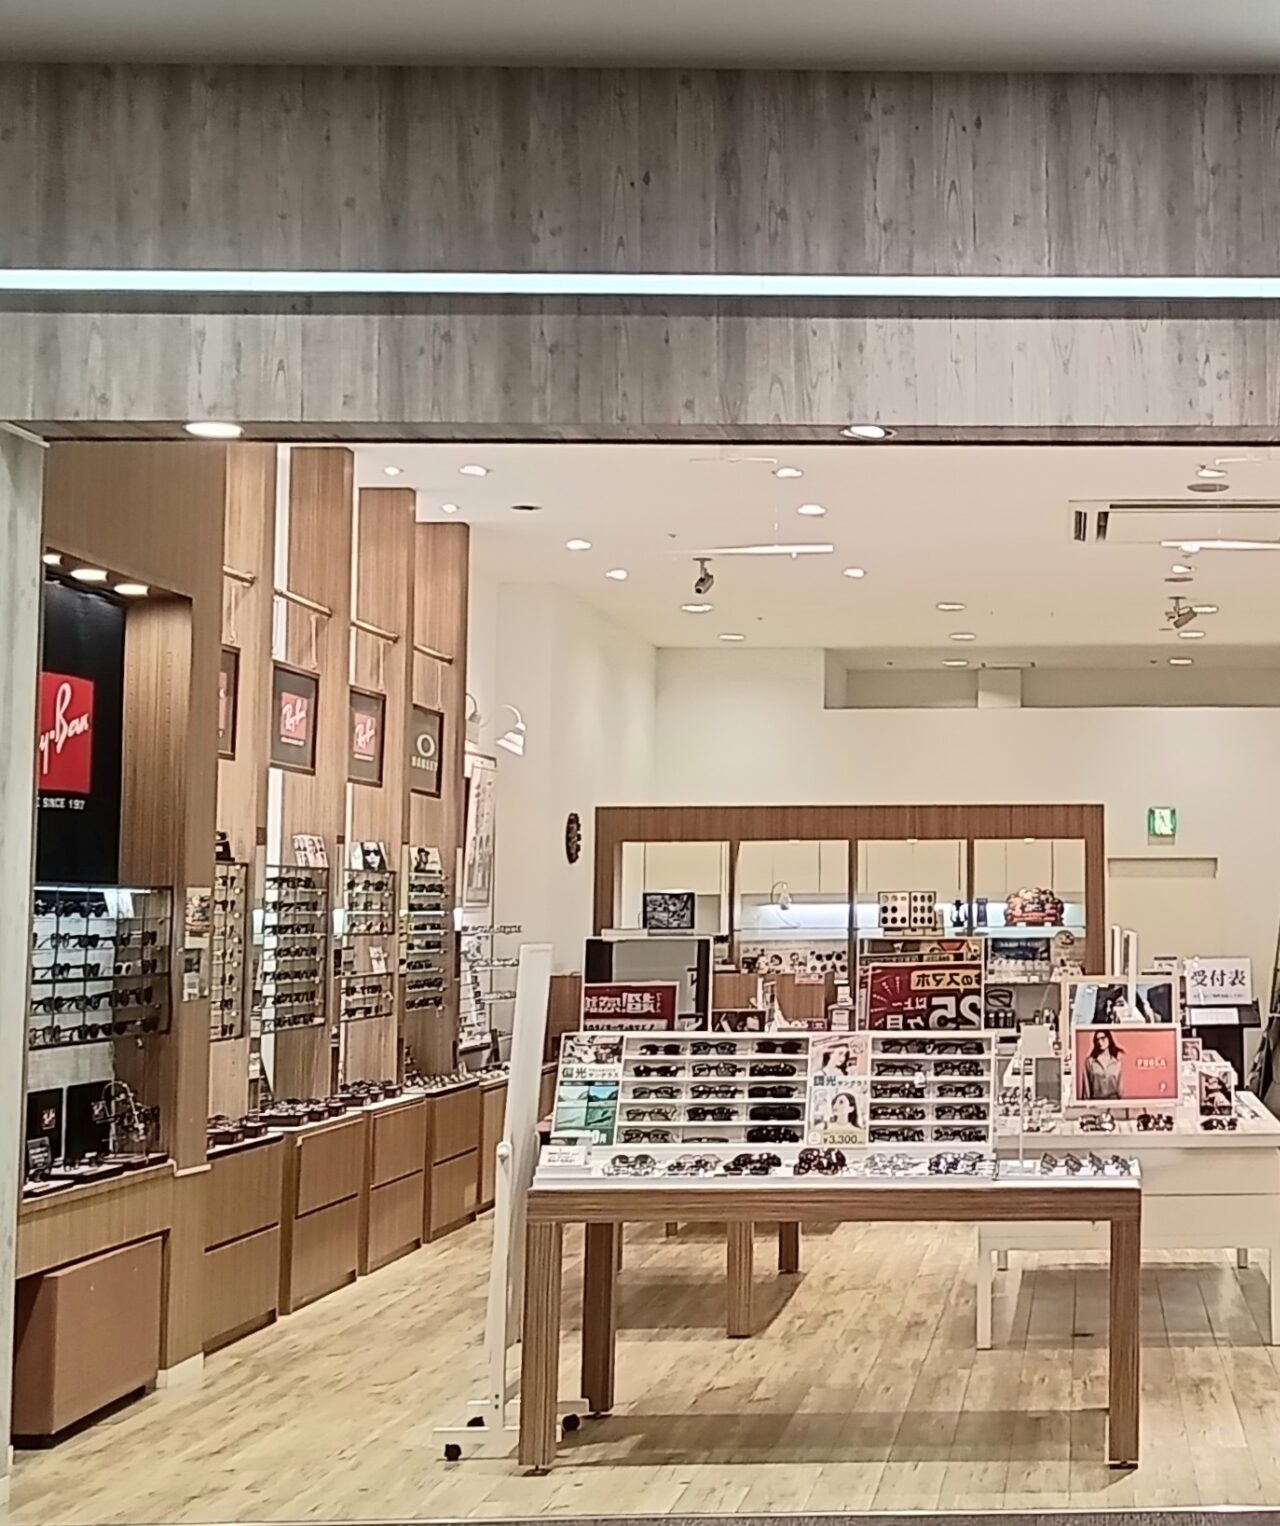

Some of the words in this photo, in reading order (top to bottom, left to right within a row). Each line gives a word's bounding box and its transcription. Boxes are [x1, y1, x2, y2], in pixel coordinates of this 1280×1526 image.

[40, 682, 89, 775] y-Ban
[1190, 969, 1247, 988] 受付表
